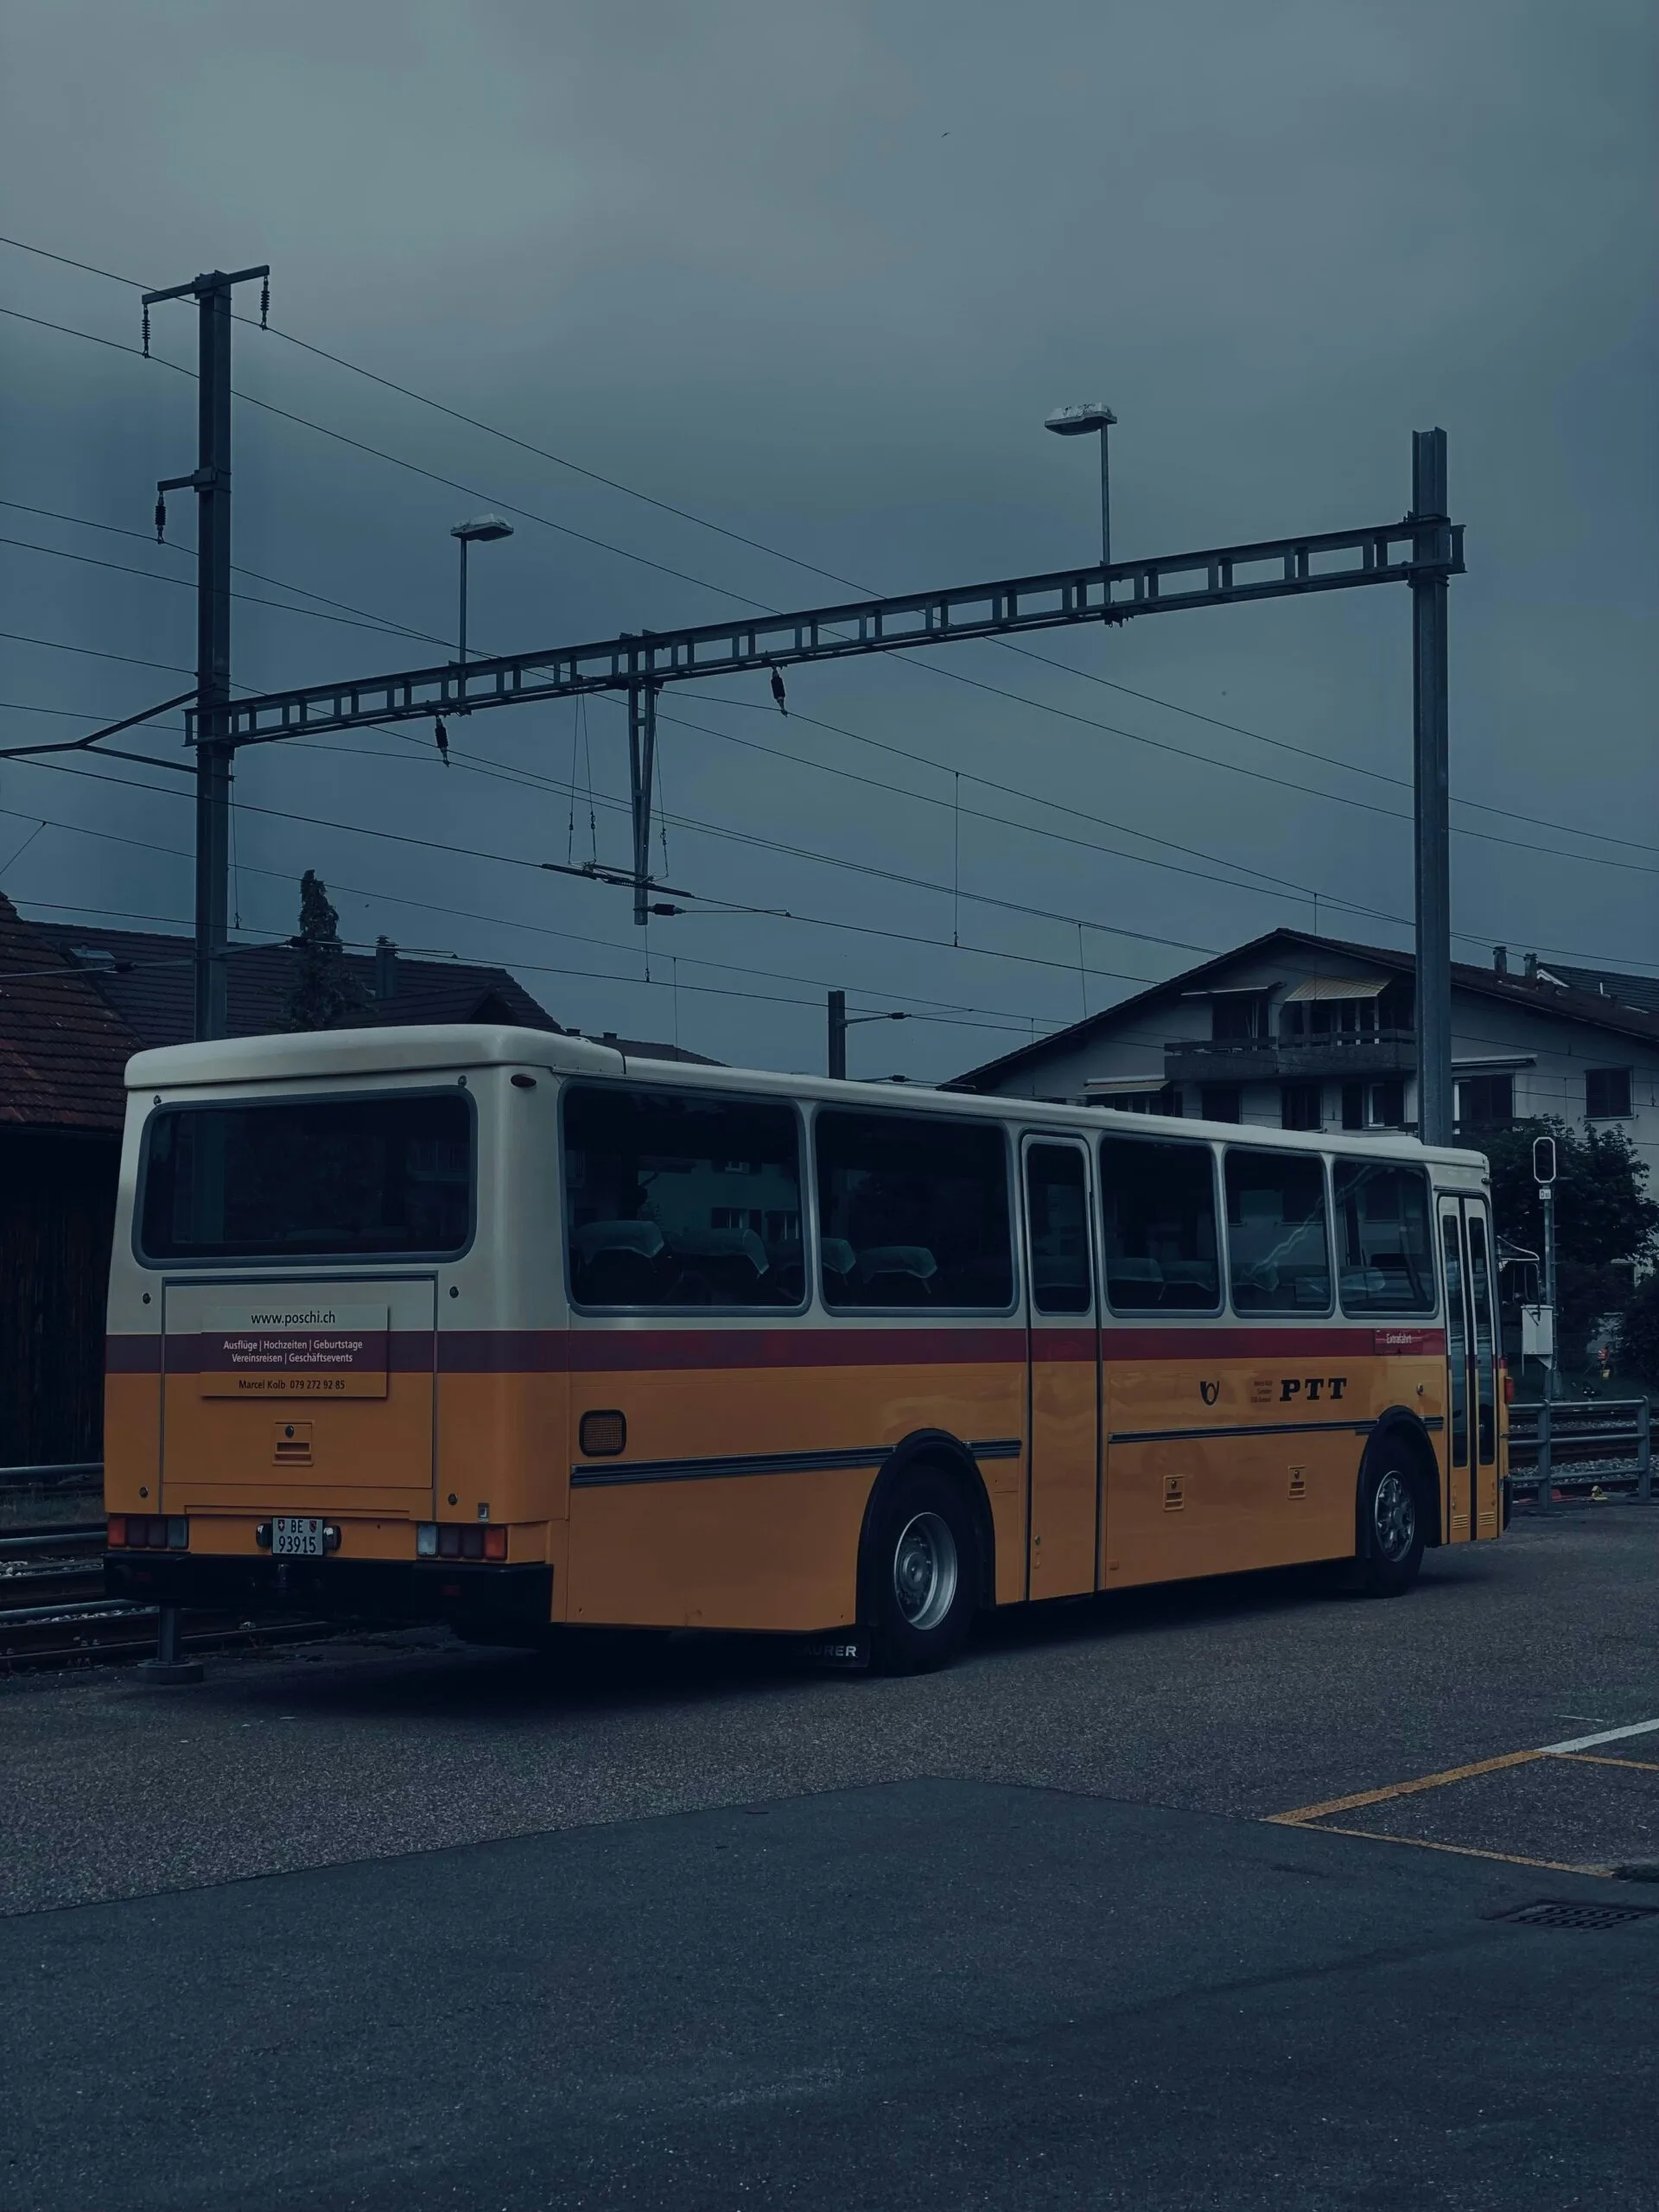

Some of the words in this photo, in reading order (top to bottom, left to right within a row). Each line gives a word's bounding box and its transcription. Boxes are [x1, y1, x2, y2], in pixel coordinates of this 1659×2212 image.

[251, 1311, 335, 1326] www.poschi.ch
[223, 1340, 257, 1351] Ausflüge
[264, 1340, 308, 1350] Hochzeiten
[314, 1339, 363, 1351] Geburtstage
[232, 1353, 283, 1363] Vereinsreisen
[289, 1352, 353, 1363] Geschäftsevents
[238, 1380, 265, 1389] Marcel
[267, 1380, 286, 1389] Kolb
[289, 1380, 304, 1389] 079
[307, 1380, 321, 1389] 272
[323, 1380, 333, 1389] 92
[335, 1380, 346, 1389] 85
[1280, 1377, 1347, 1402] PTT
[290, 1519, 303, 1534] BE
[278, 1535, 316, 1553] 93915
